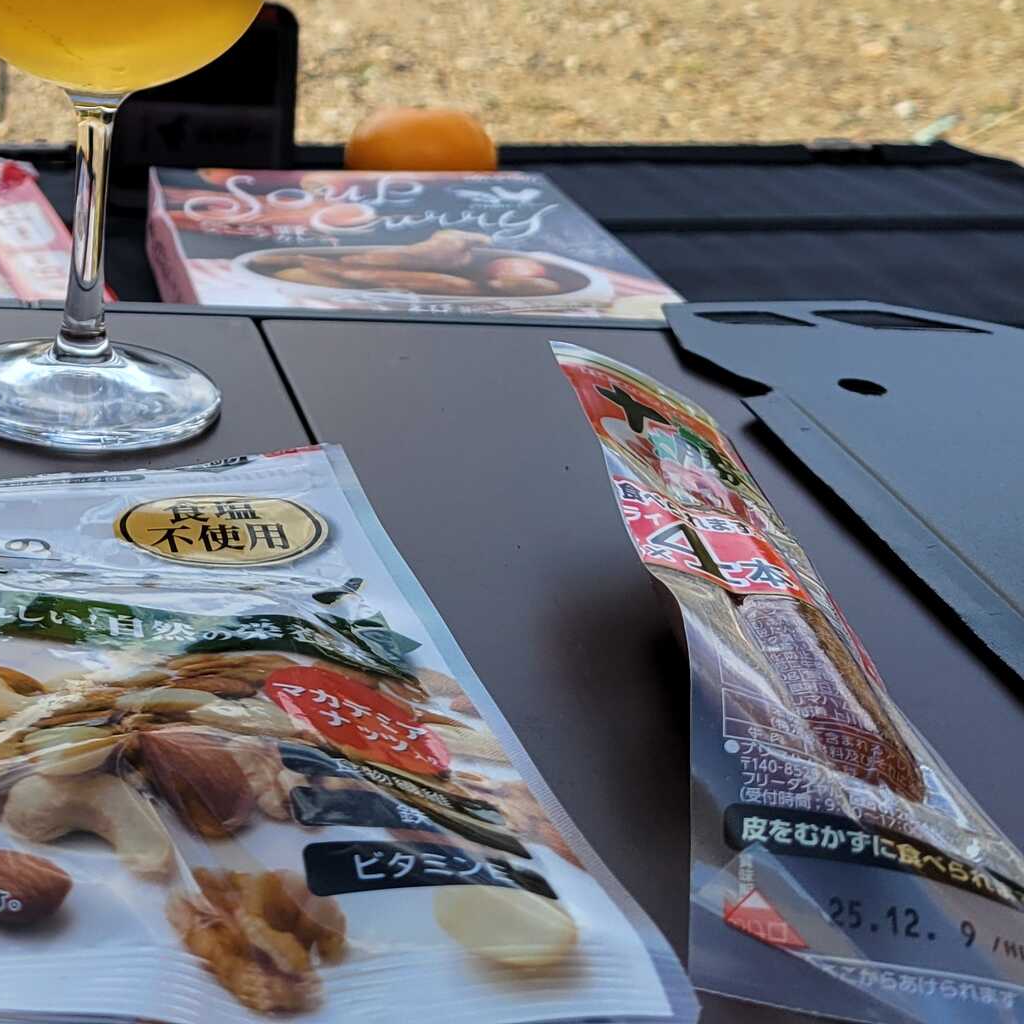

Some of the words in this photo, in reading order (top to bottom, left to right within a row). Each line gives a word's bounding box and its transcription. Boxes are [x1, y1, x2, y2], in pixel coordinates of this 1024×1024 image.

[183, 174, 425, 223] Soup
[309, 202, 557, 249] Curry
[164, 501, 262, 525] 食塩
[148, 522, 290, 553] 不使用
[271, 682, 430, 742] マカデミア
